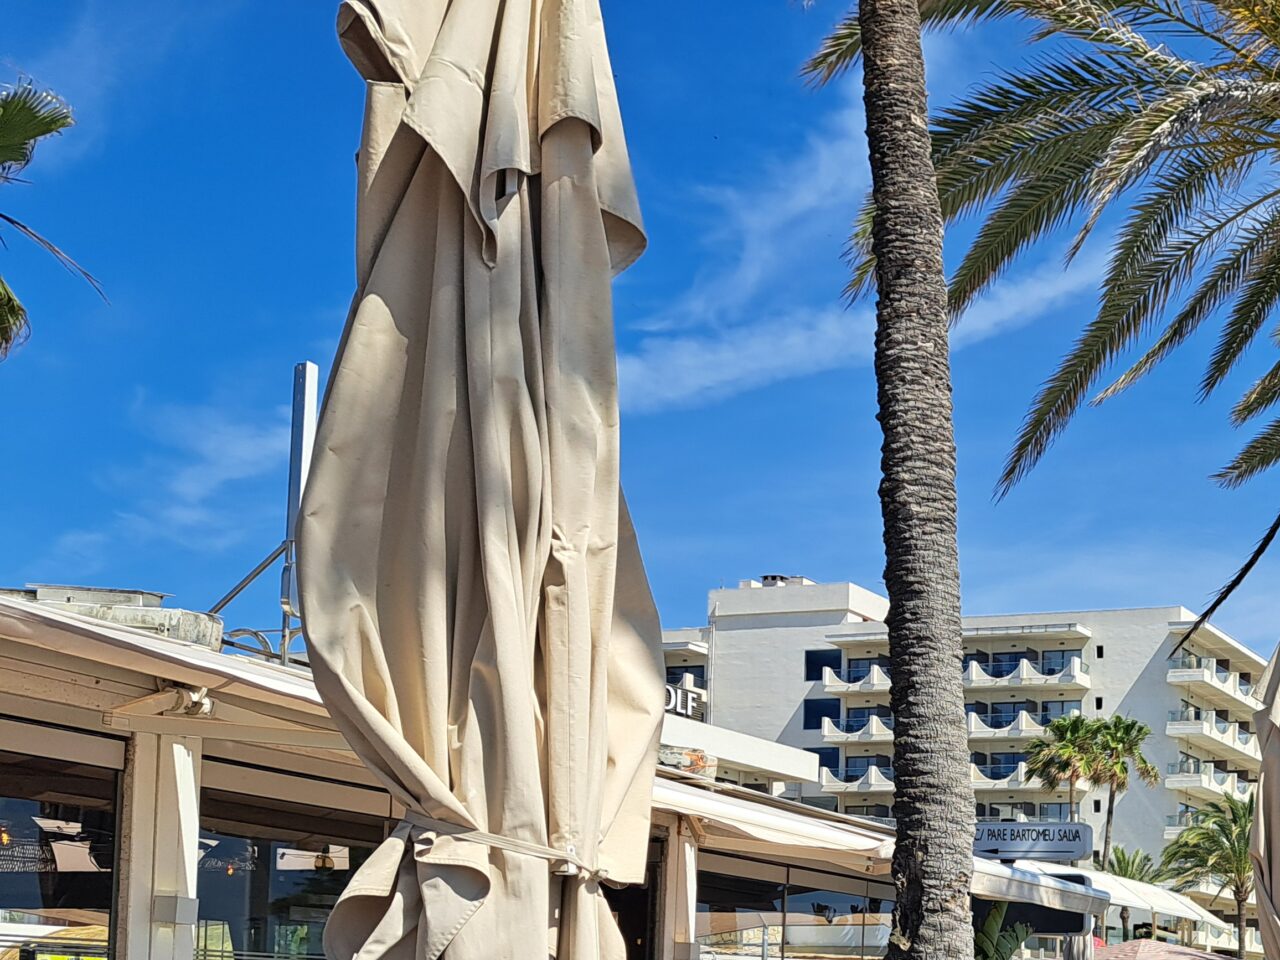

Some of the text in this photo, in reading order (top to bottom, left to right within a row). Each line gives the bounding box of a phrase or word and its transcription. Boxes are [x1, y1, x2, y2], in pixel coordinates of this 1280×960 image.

[987, 828, 1008, 841] PARE
[1010, 828, 1055, 841] BARTOMEU
[1057, 828, 1082, 842] SALVA
